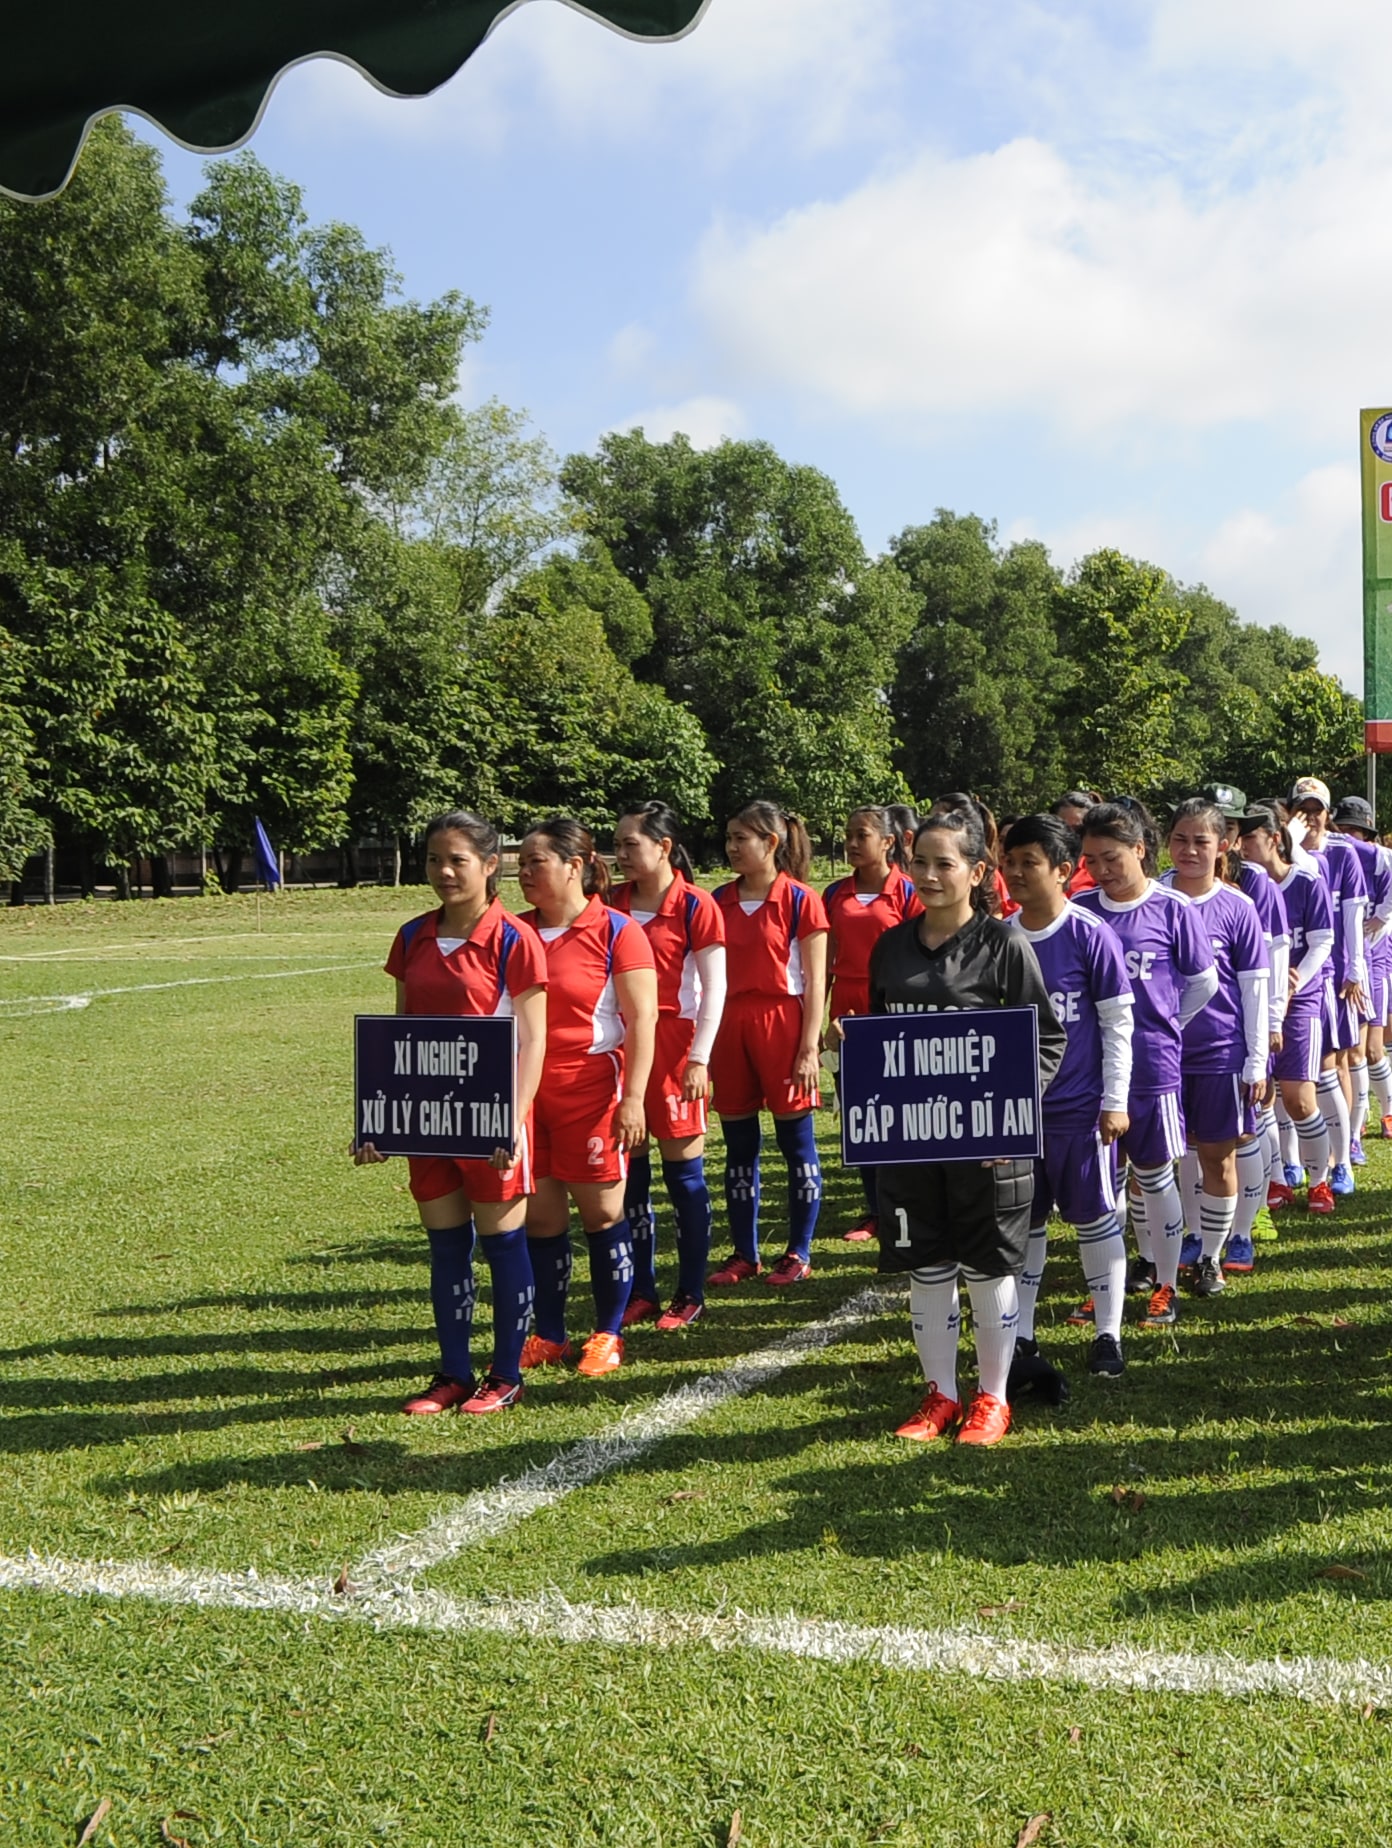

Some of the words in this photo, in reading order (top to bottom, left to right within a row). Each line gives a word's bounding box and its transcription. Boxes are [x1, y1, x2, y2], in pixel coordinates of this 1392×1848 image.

[393, 1033, 412, 1075] XÍ
[417, 1035, 479, 1085] NGHIỆP
[882, 1031, 906, 1078] XÍ
[913, 1028, 996, 1082] NGHIỆP
[362, 1089, 387, 1135] XỬ
[392, 1093, 413, 1135] LÝ
[419, 1091, 464, 1136] CHẤT
[470, 1092, 509, 1138] THẢI
[849, 1094, 895, 1144] CẤP
[902, 1094, 964, 1141] NƯỚC
[971, 1091, 994, 1138] DĨ
[1002, 1097, 1034, 1137] AN
[587, 1136, 605, 1165] 2
[894, 1207, 912, 1248] 1
